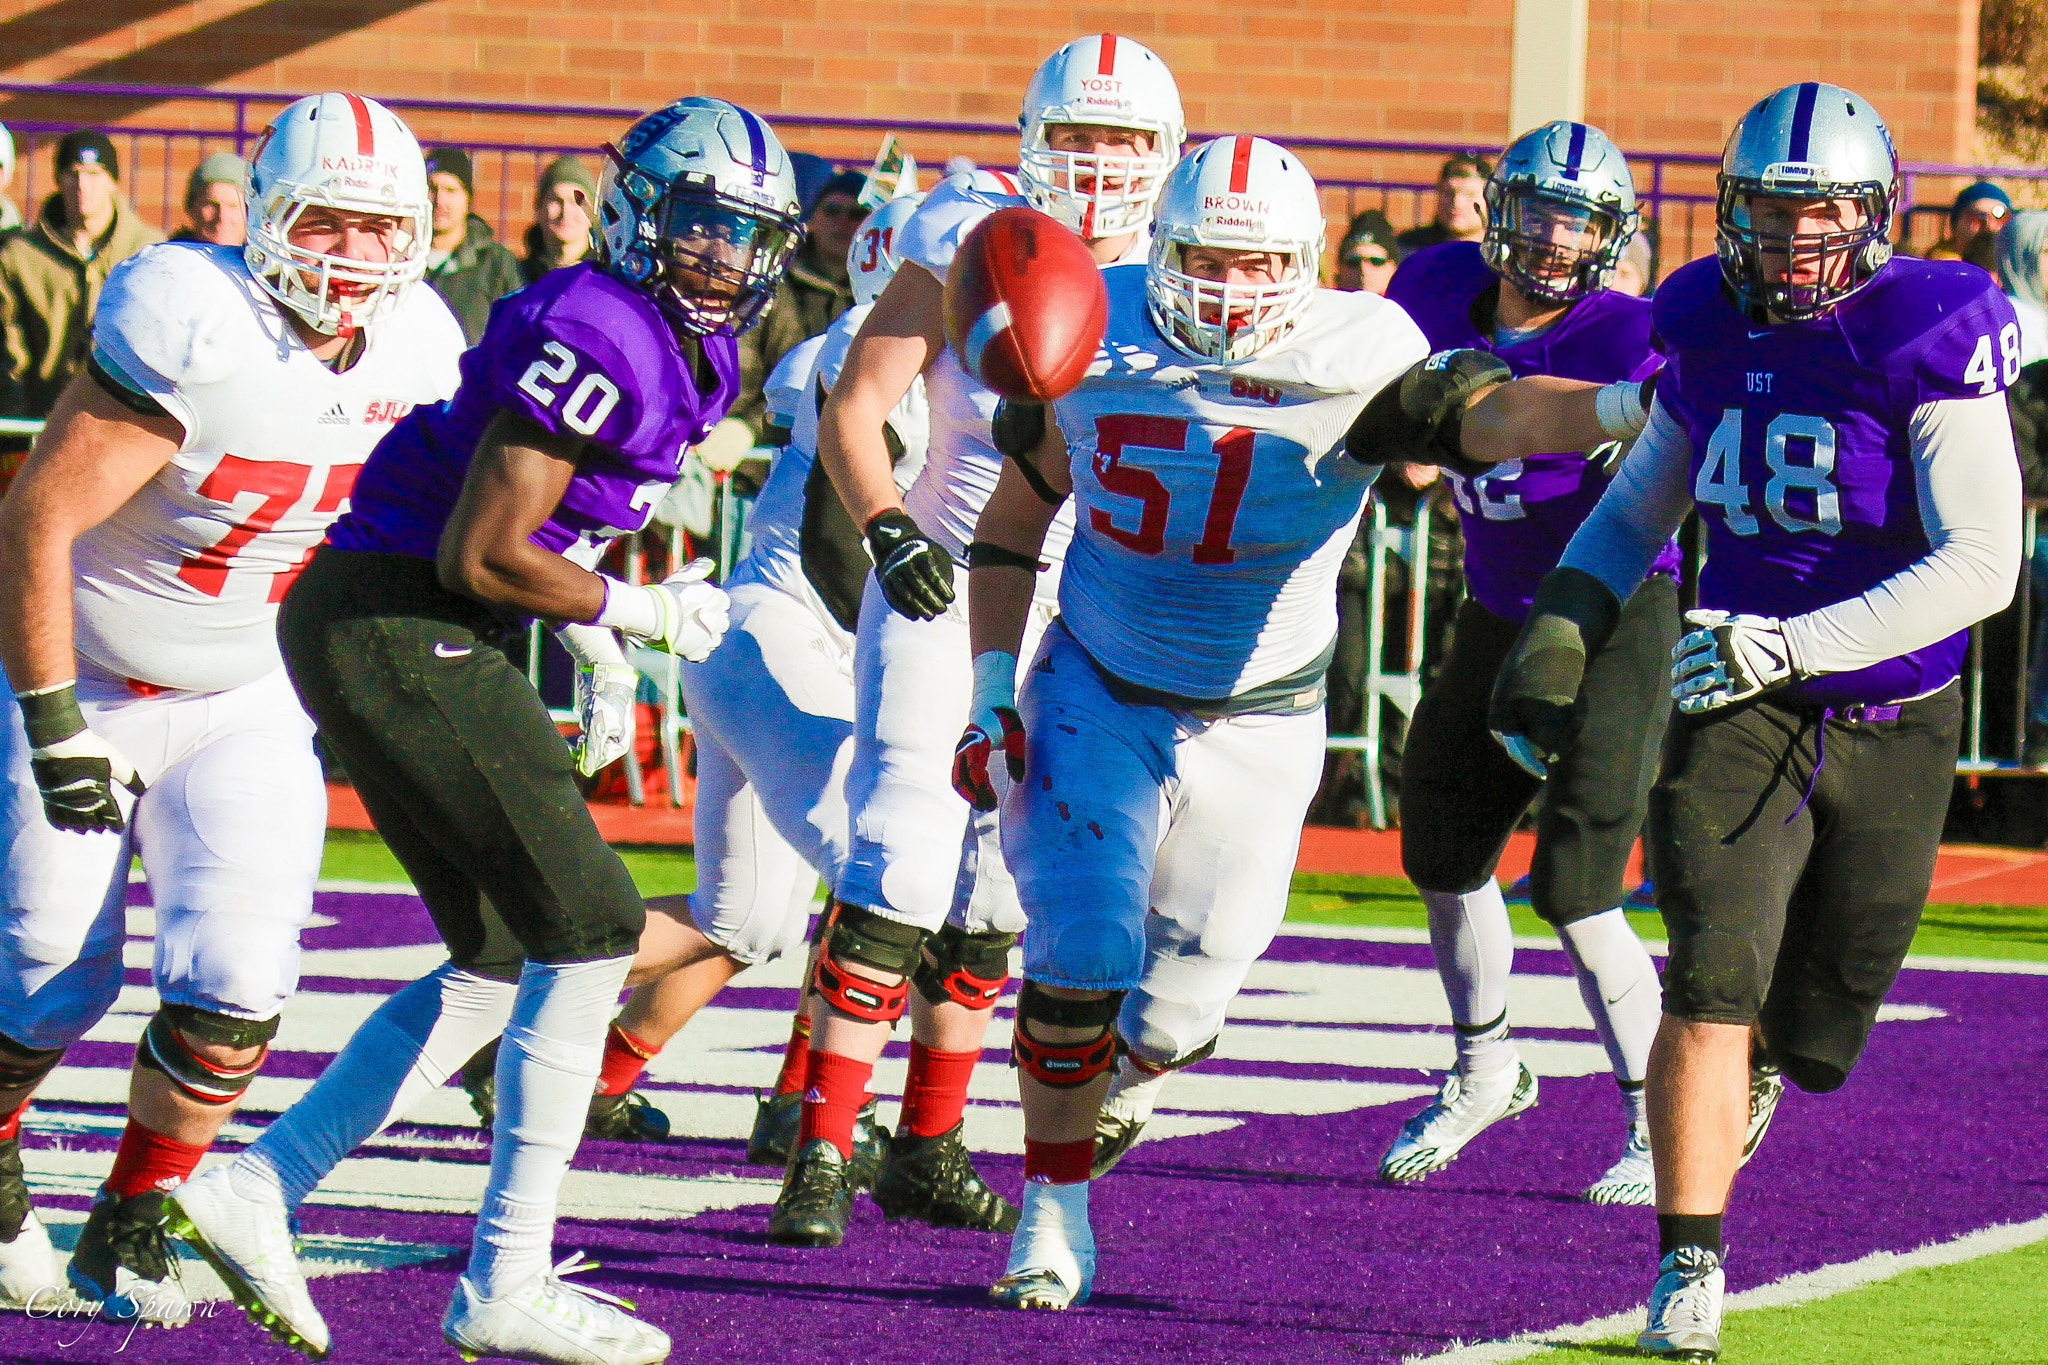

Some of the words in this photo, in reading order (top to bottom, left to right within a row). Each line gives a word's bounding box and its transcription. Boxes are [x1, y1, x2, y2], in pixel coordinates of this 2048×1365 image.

[1081, 79, 1122, 92] YOST
[1086, 96, 1121, 108] Riddell
[1204, 196, 1270, 214] BROWN
[861, 226, 893, 273] 31
[1963, 321, 2021, 395] 48
[517, 340, 620, 436] 20
[1746, 372, 1774, 393] UST
[363, 400, 408, 425] SJU
[1088, 413, 1257, 566] 51
[1695, 408, 1843, 537] 48
